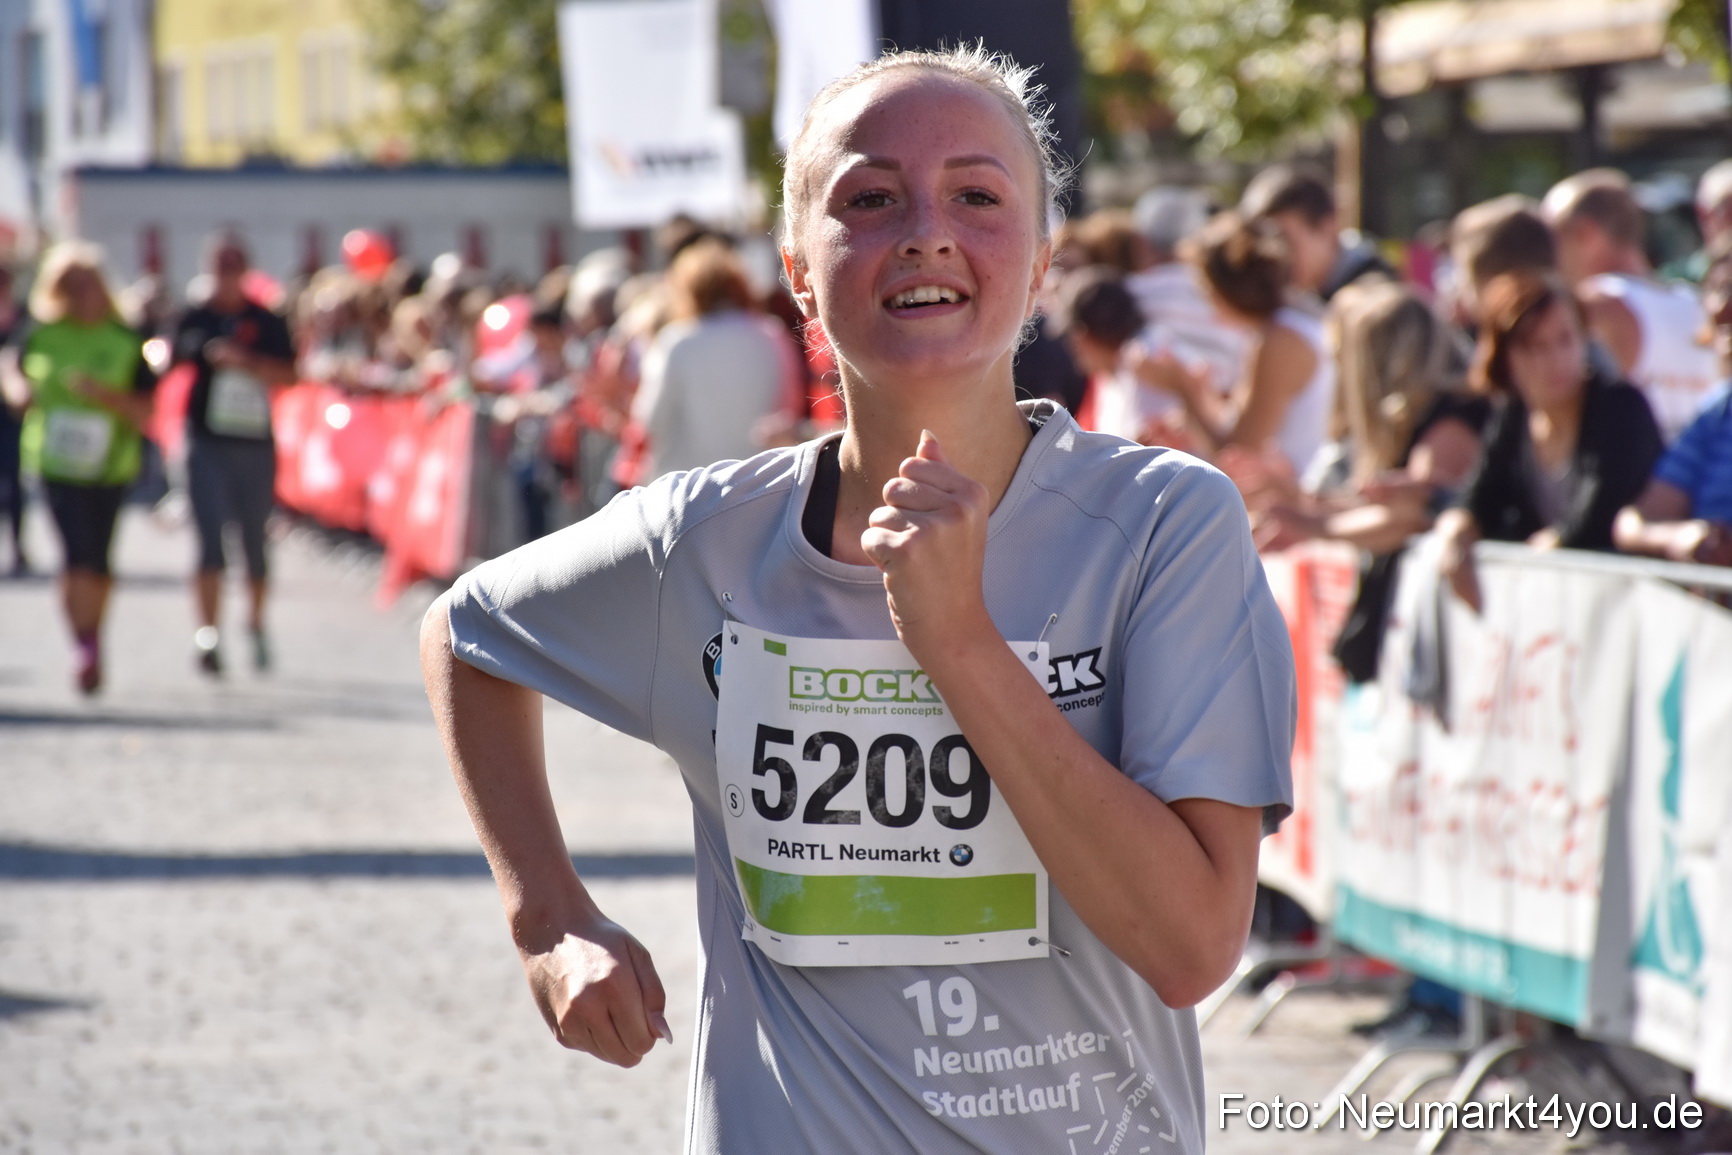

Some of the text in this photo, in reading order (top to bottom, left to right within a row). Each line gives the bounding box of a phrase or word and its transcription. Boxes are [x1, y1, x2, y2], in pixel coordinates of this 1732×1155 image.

[789, 666, 942, 703] BOCK
[1056, 691, 1105, 712] concep
[789, 700, 944, 718] inspired by smart concepts
[751, 723, 992, 830] 5209
[730, 792, 738, 810] S
[768, 838, 941, 863] PARTL Neumarkt
[903, 976, 1000, 1037] 19.
[913, 1030, 1111, 1077] Neumarkter
[921, 1072, 1082, 1119] Stadtlauf
[1127, 1072, 1155, 1108] 2018
